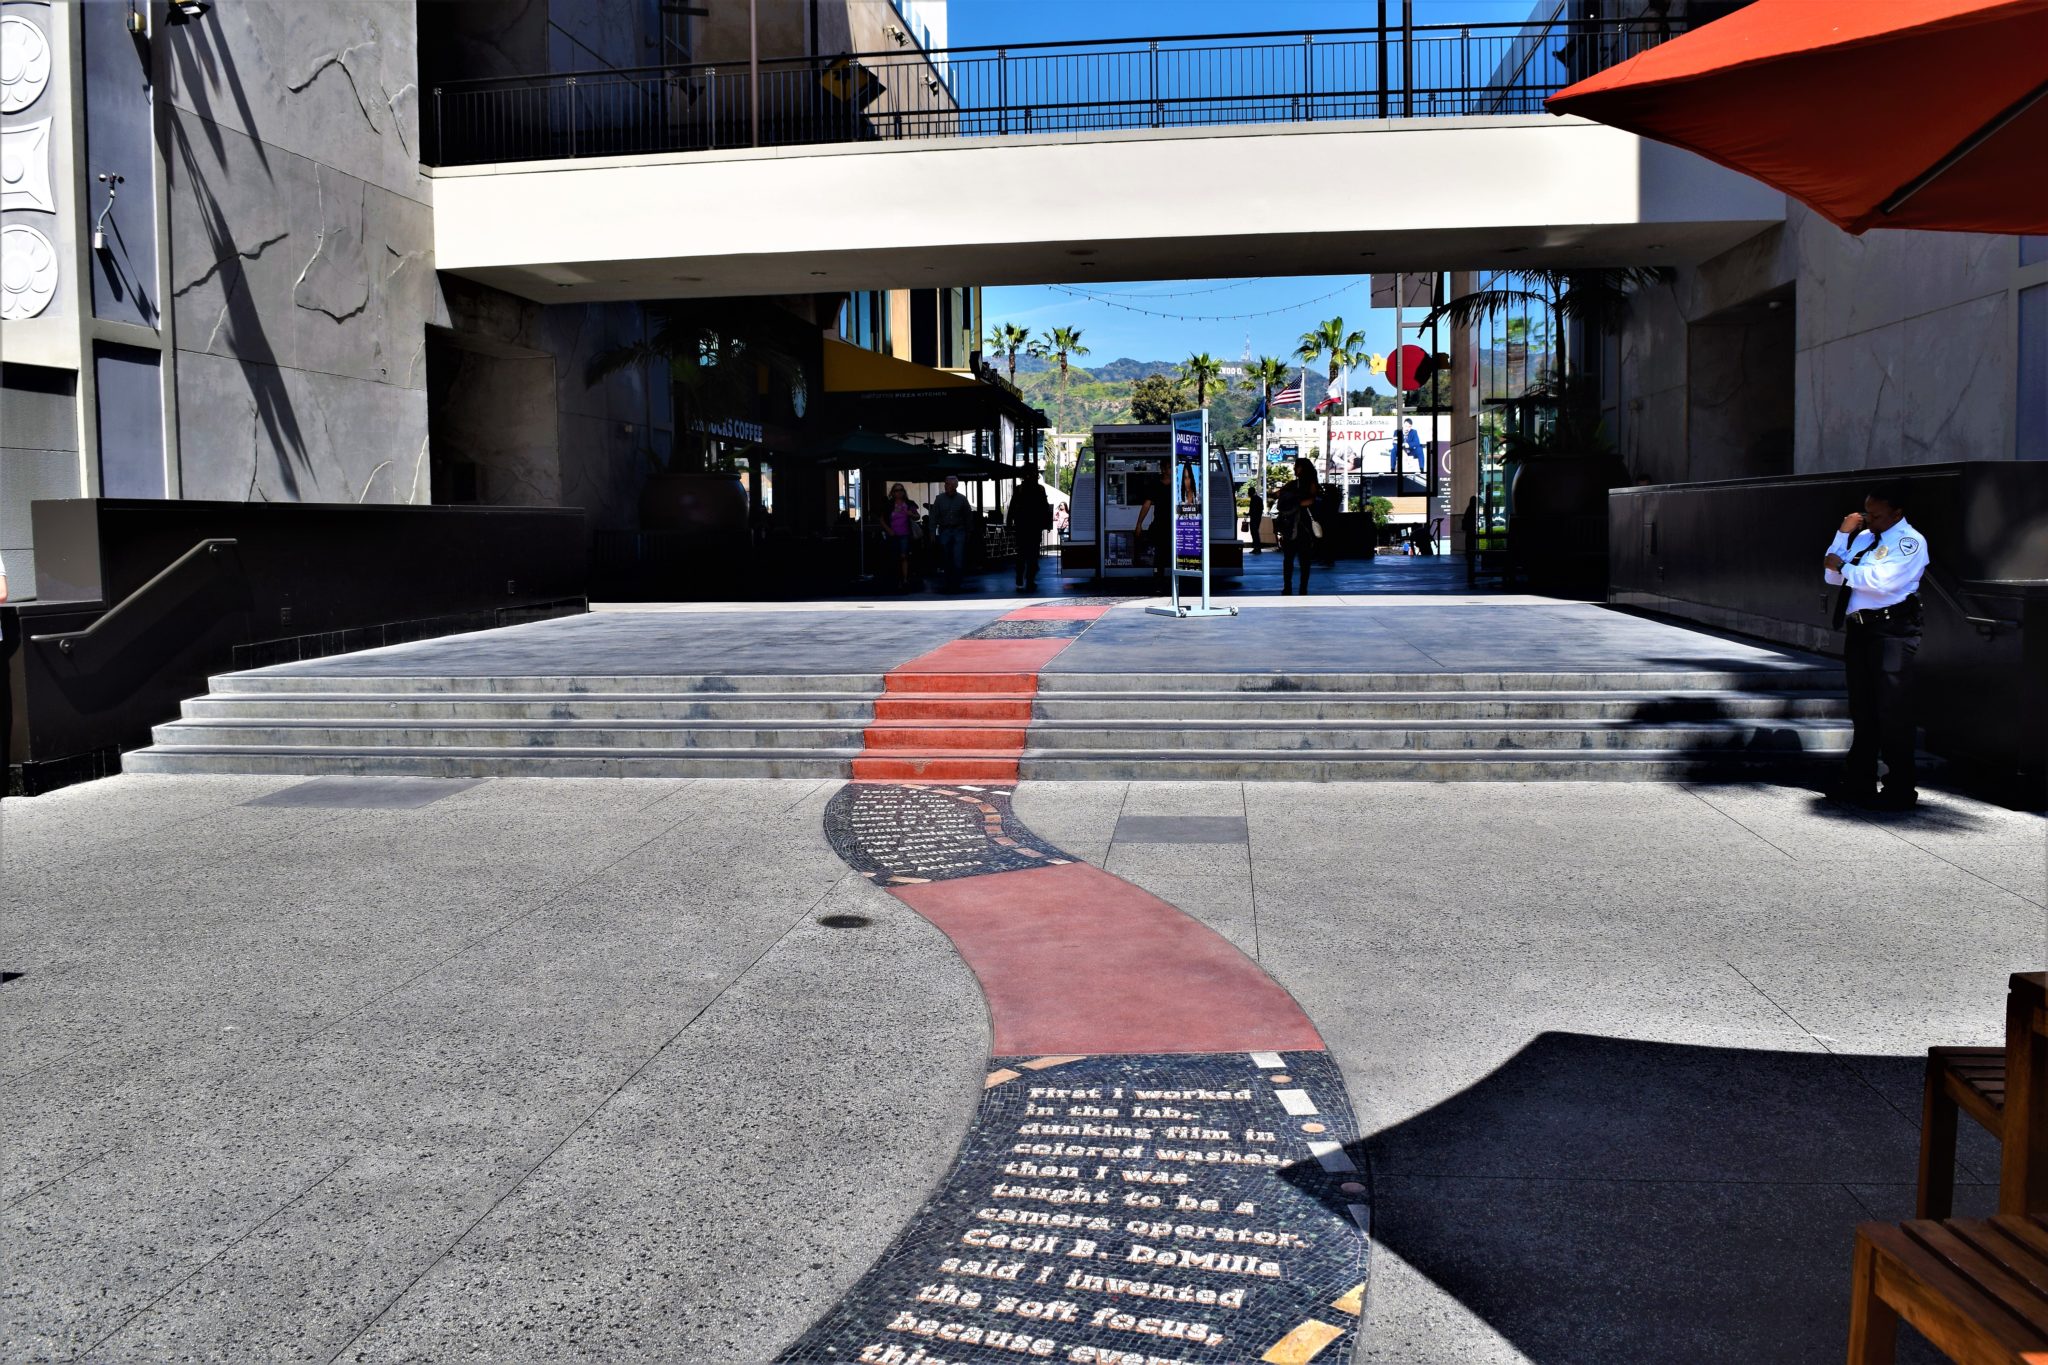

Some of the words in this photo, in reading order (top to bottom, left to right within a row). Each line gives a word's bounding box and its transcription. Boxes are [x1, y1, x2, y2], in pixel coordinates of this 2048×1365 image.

[734, 418, 763, 443] COFFEE
[1176, 433, 1202, 446] PALEYFES
[1329, 430, 1385, 442] PATRIOT
[1027, 1087, 1102, 1100] First
[1111, 1088, 1124, 1099] I
[1135, 1088, 1254, 1100] worked
[1023, 1104, 1055, 1117] in
[1066, 1104, 1120, 1118] the
[1132, 1106, 1200, 1121] lab,
[1017, 1123, 1152, 1140] dunking
[1165, 1126, 1231, 1141] film
[1245, 1128, 1277, 1143] in
[1013, 1142, 1144, 1159] colored
[1155, 1148, 1296, 1167] washes,
[1003, 1161, 1079, 1179] then
[1094, 1164, 1108, 1180] I
[1121, 1169, 1194, 1185] was
[991, 1182, 1109, 1204] taught
[1122, 1191, 1162, 1207] to
[1175, 1194, 1221, 1212] be
[1234, 1200, 1258, 1215] a
[975, 1207, 1111, 1230] camera
[1125, 1218, 1305, 1249] operator.
[961, 1228, 1059, 1254] Cecil
[1066, 1238, 1109, 1260] B.
[1125, 1244, 1282, 1277] DeMille
[936, 1255, 1027, 1282] said
[1034, 1266, 1052, 1286] I
[1064, 1269, 1248, 1310] invented
[914, 1282, 984, 1310] the
[992, 1294, 1080, 1324] soft
[1087, 1307, 1226, 1347] focus,
[885, 1310, 1059, 1357] because
